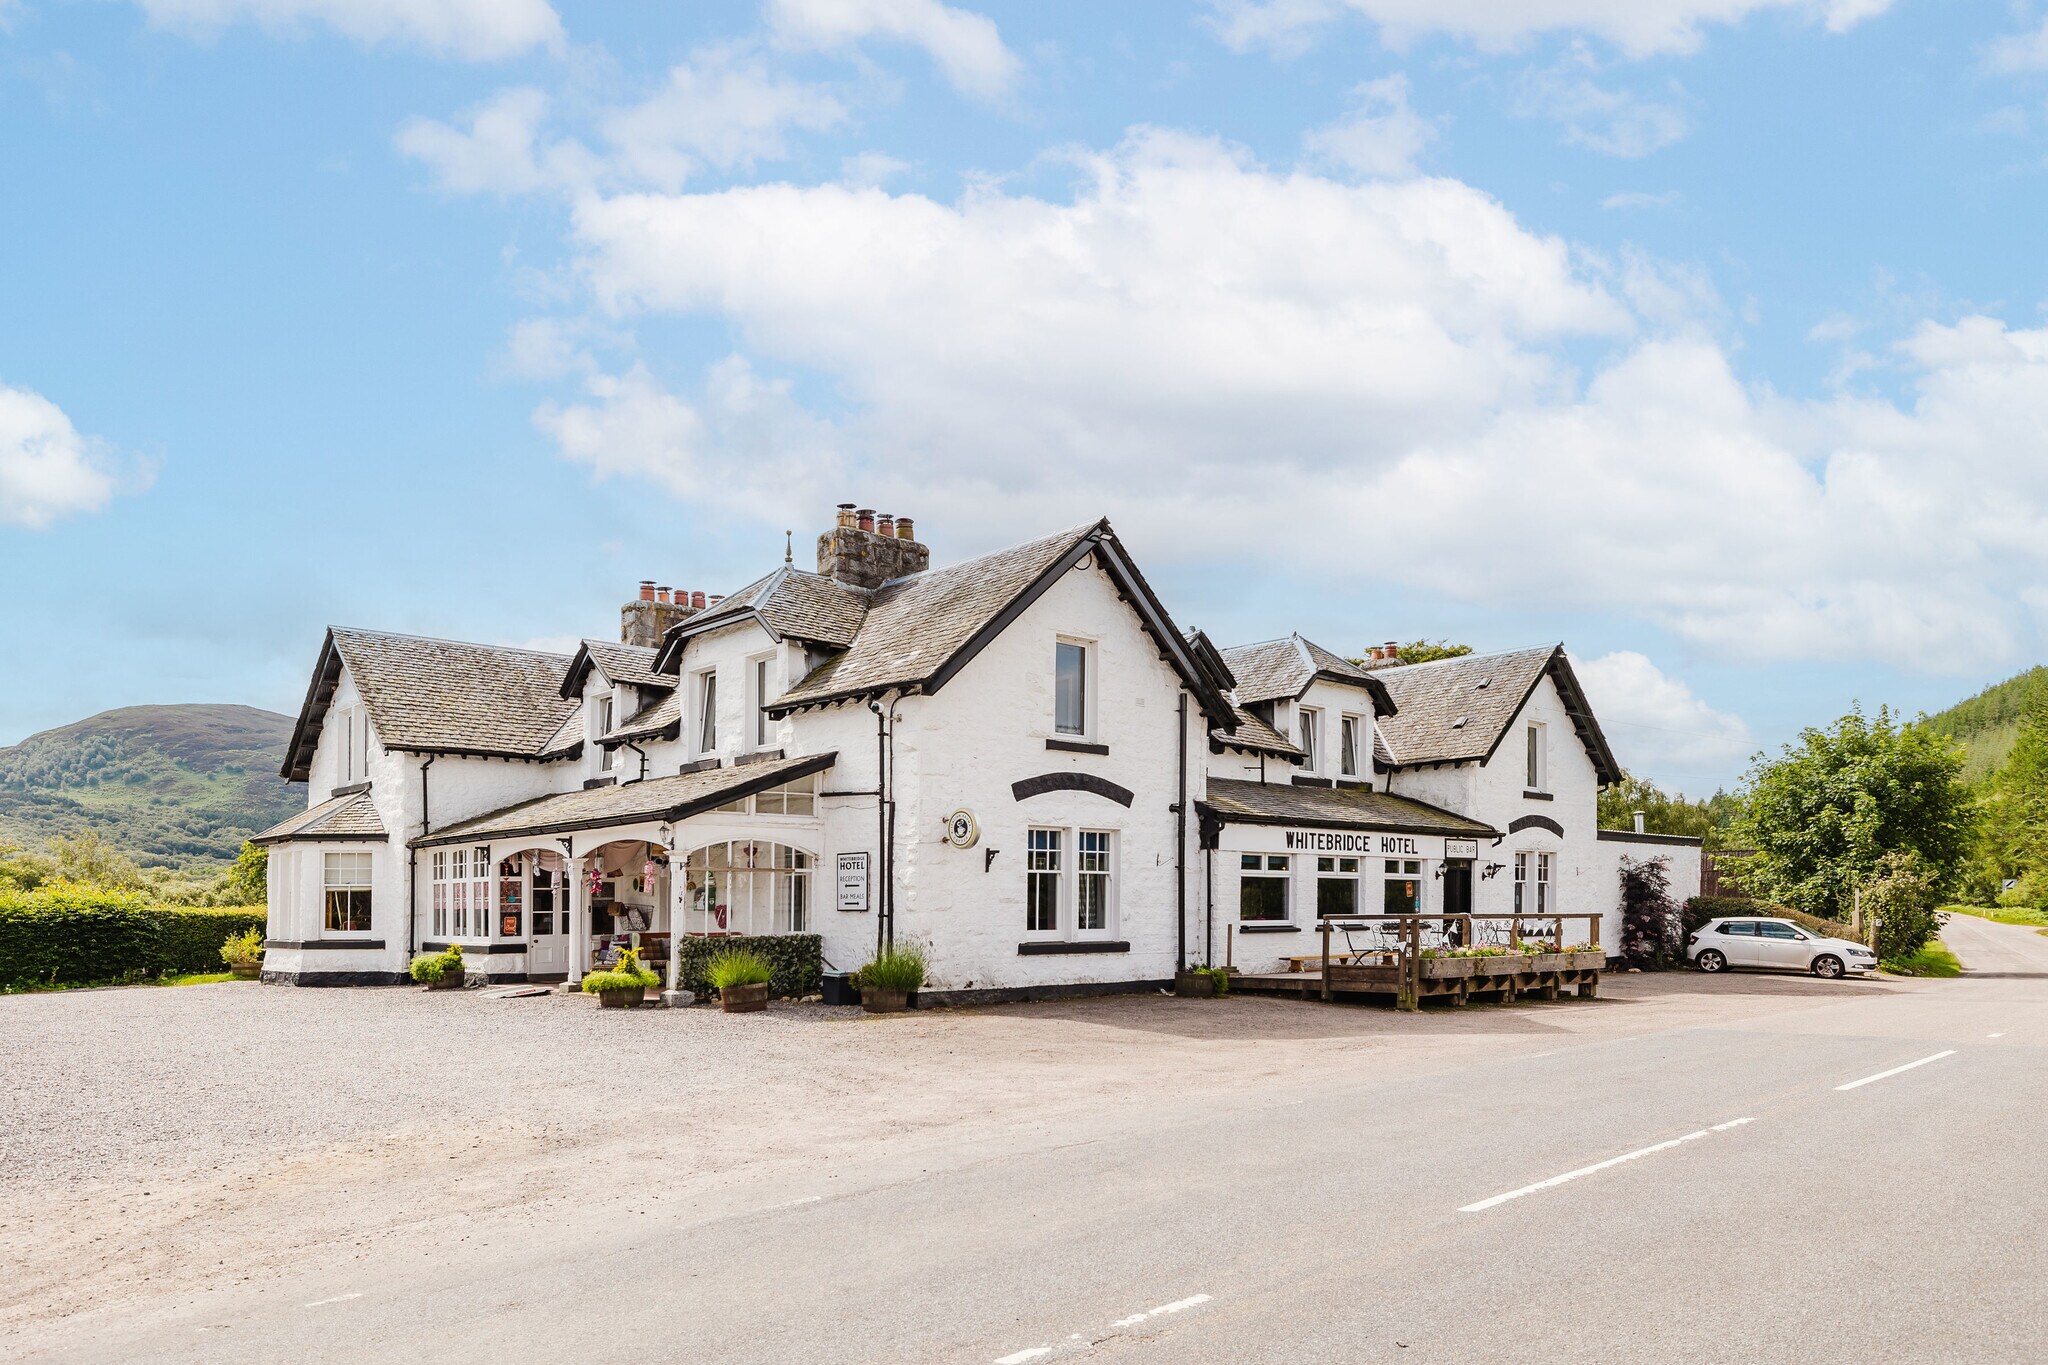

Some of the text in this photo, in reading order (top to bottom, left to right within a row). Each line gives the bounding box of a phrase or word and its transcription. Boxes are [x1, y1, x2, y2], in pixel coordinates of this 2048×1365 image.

[1286, 831, 1418, 855] WHITEBRIDGE HOTEL
[1447, 844, 1476, 854] PUBLIC BAR
[840, 861, 865, 870] HOTEL
